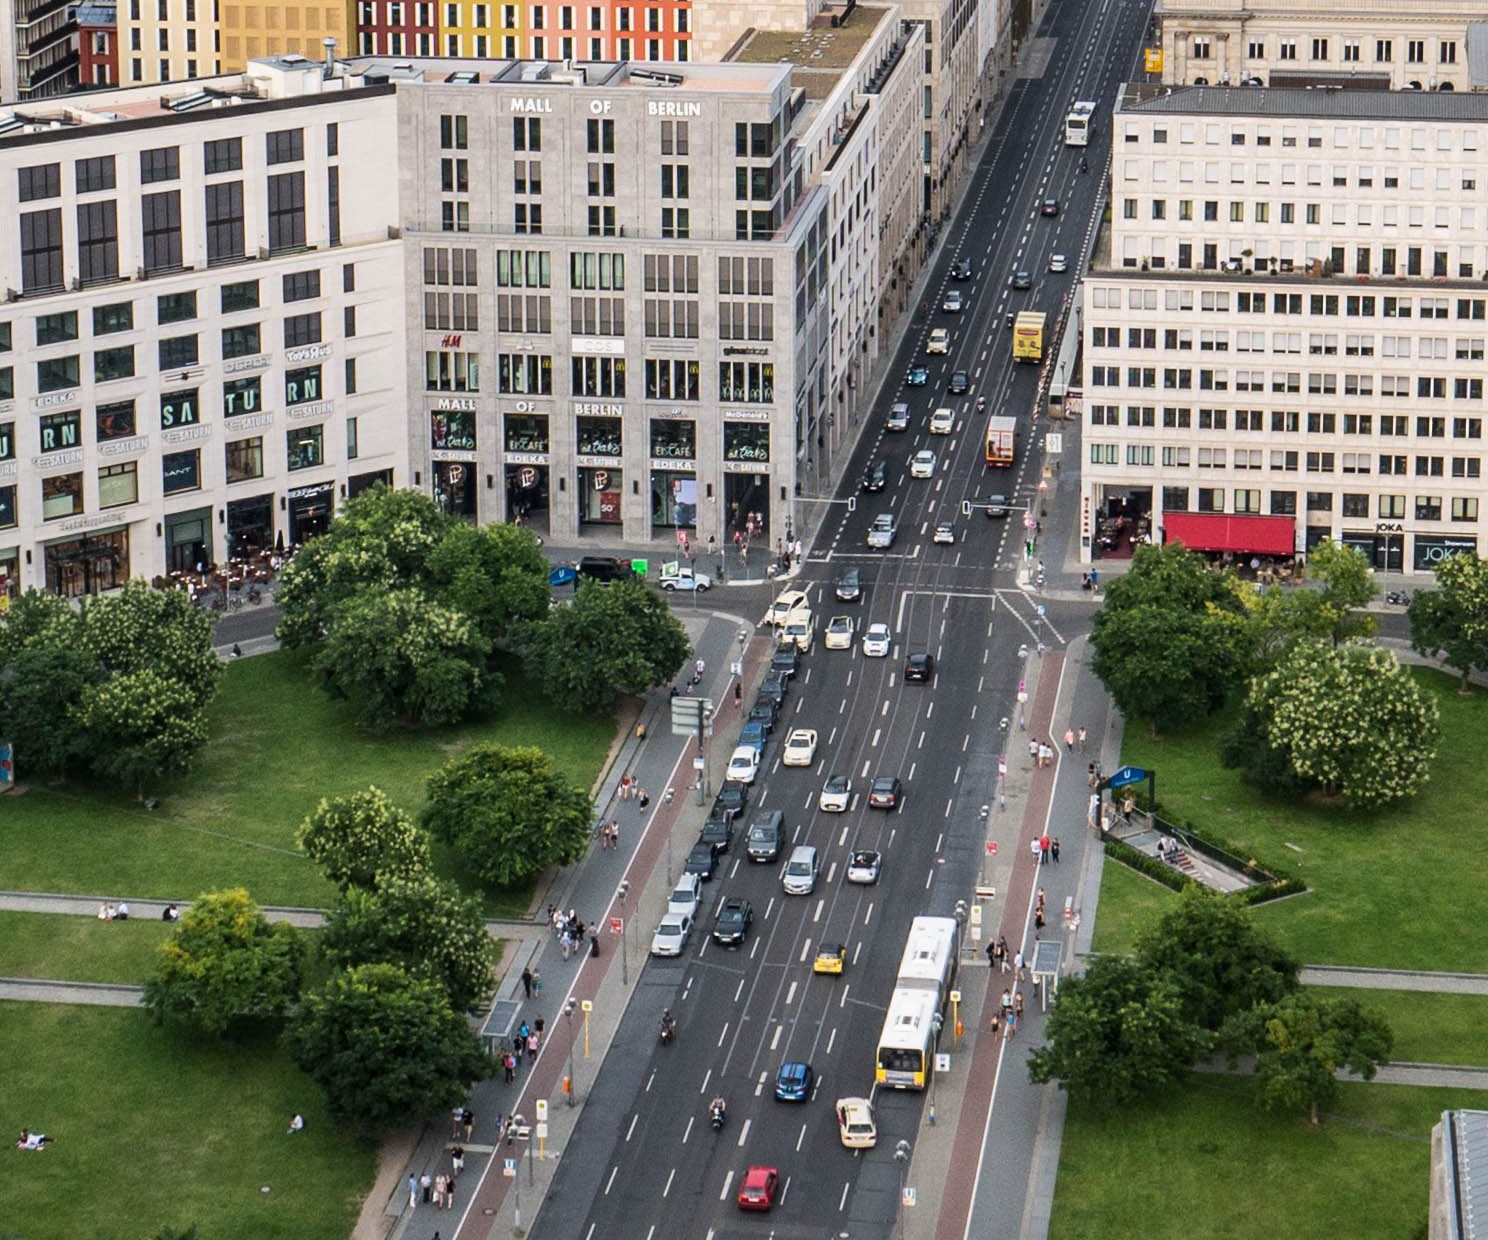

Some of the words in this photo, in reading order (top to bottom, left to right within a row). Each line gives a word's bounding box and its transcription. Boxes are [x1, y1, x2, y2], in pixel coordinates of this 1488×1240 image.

[510, 98, 552, 113] MALL
[590, 99, 611, 114] OF
[648, 101, 701, 116] BERLIN
[438, 399, 476, 410] MALL
[516, 401, 536, 412] OF
[575, 404, 623, 416] BERLIN
[653, 460, 692, 469] EDEKA
[1376, 523, 1403, 533] JOKA
[1123, 769, 1131, 779] U
